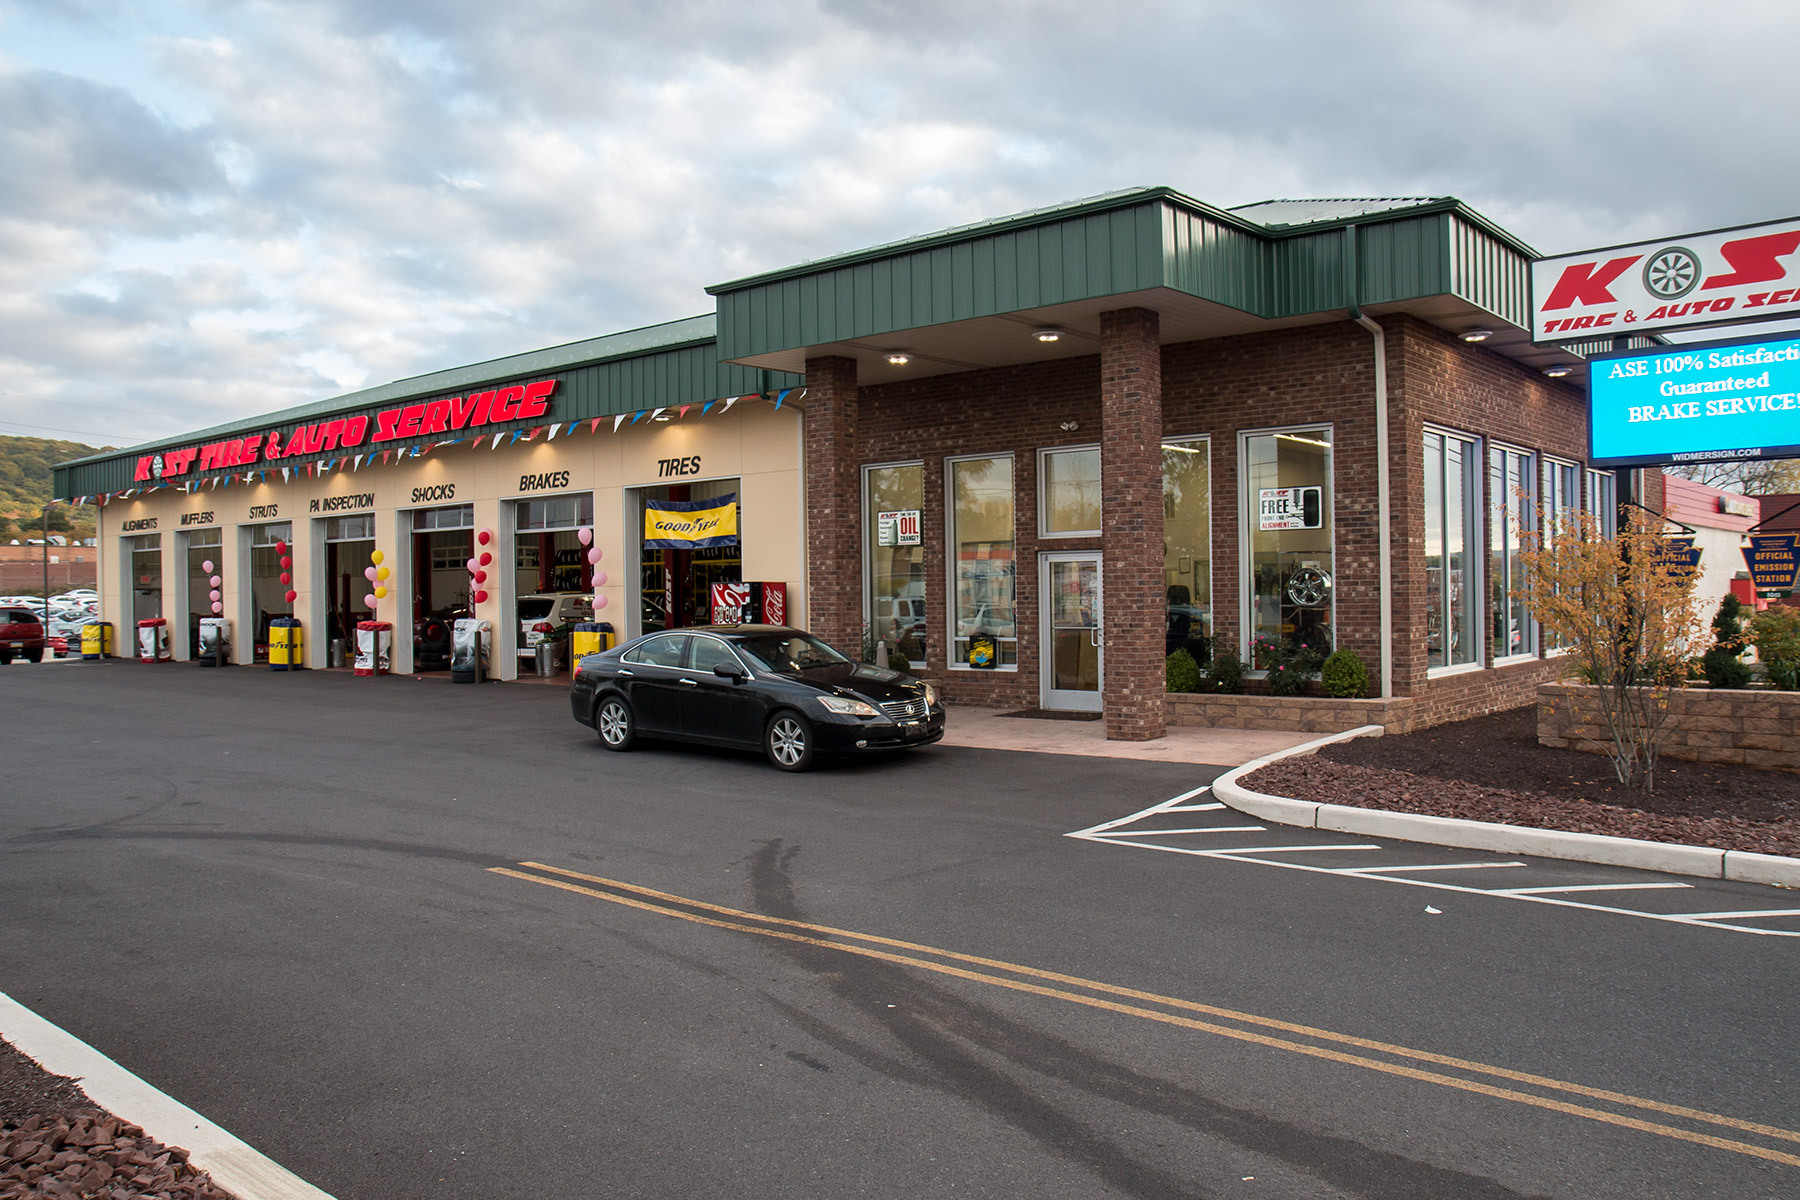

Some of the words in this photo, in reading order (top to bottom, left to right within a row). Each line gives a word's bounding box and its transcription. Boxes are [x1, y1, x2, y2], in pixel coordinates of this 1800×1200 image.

[1540, 230, 1800, 312] KOS
[1543, 312, 1618, 334] TIRE
[1623, 309, 1638, 323] &
[1643, 297, 1735, 322] AUTO
[1608, 360, 1649, 379] ASE
[1655, 355, 1704, 375] 100%
[1708, 343, 1800, 369] Satisfacti
[1660, 371, 1770, 397] Guaranteed
[1628, 401, 1702, 423] BRAKE
[200, 434, 263, 471] TIRE
[265, 431, 284, 460] &
[282, 414, 370, 458] AUTO
[371, 379, 559, 443] SERVICE
[1671, 448, 1762, 461] WIDMERSIGN.COM
[657, 455, 702, 478] TIRES
[519, 470, 570, 492] BRAKES
[411, 483, 456, 503] SHOCKS
[249, 504, 278, 519] STRUTS
[309, 499, 320, 513] PA
[322, 493, 375, 511] INSPECTION
[1261, 499, 1289, 514] FREE
[121, 517, 158, 532] ALIGNMENTS
[180, 511, 215, 526] MUFFLERS
[901, 517, 919, 535] OIL
[1261, 521, 1290, 529] ALIGNMENT
[1754, 552, 1794, 560] OFFICIAL
[1754, 563, 1795, 572] EMISSION
[1755, 574, 1792, 583] STATION
